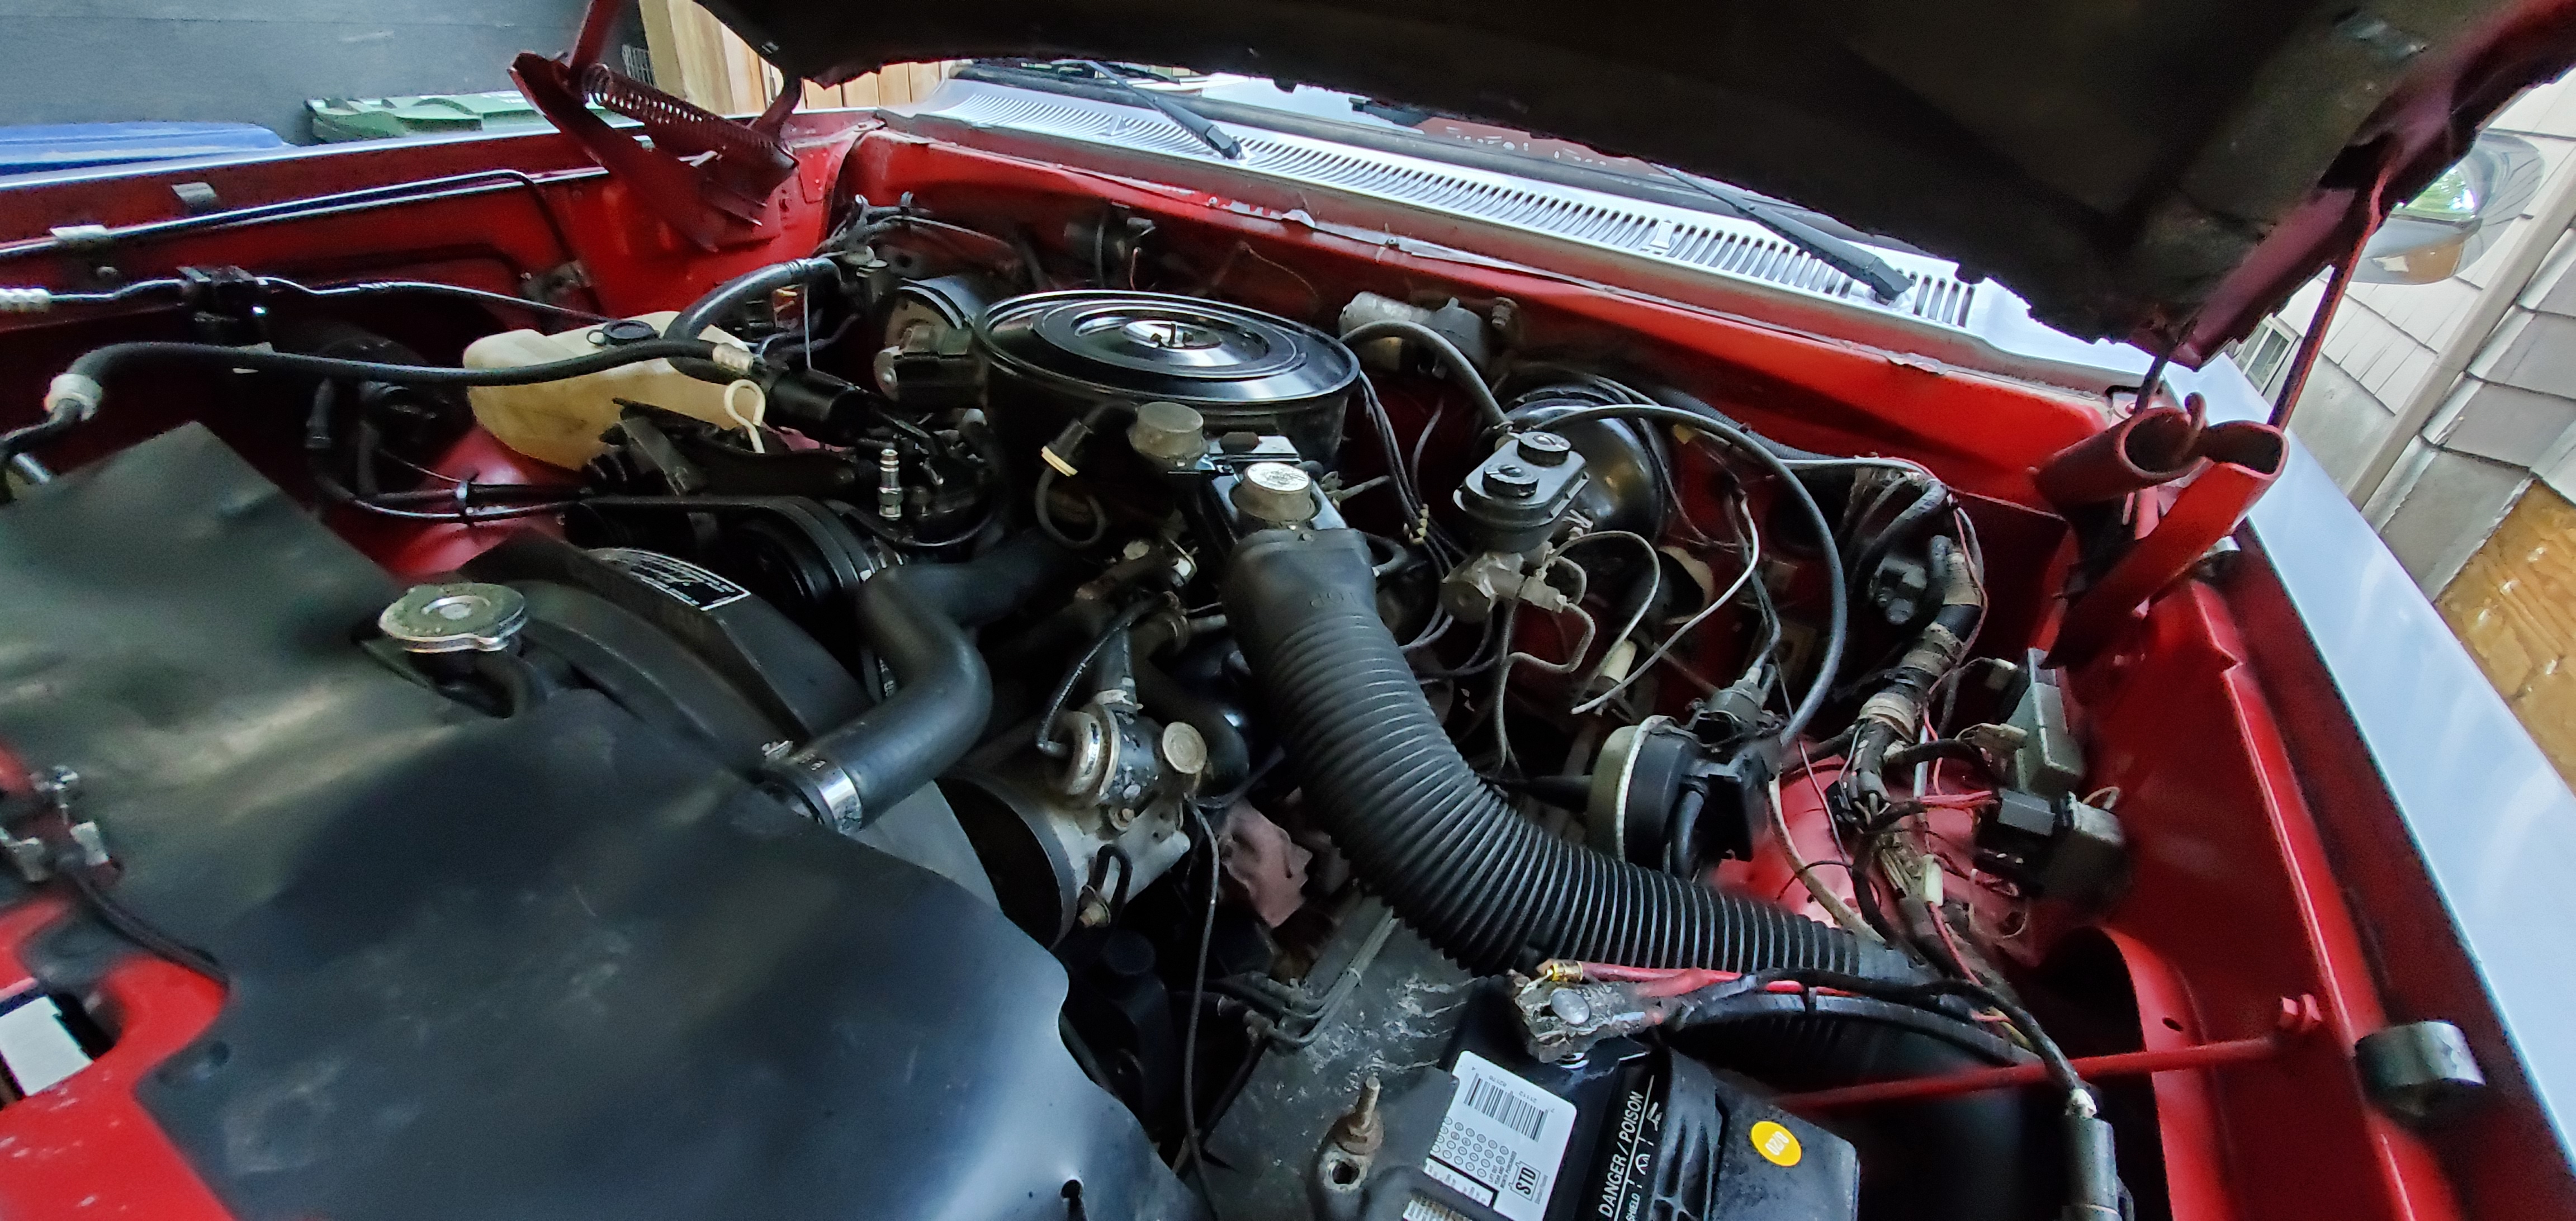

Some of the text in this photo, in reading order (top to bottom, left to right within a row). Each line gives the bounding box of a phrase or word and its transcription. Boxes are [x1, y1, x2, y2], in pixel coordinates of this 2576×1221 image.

[1516, 1167, 1536, 1195] STD
[1598, 1153, 1627, 1218] DANGER
[1619, 1091, 1644, 1143] POISON
